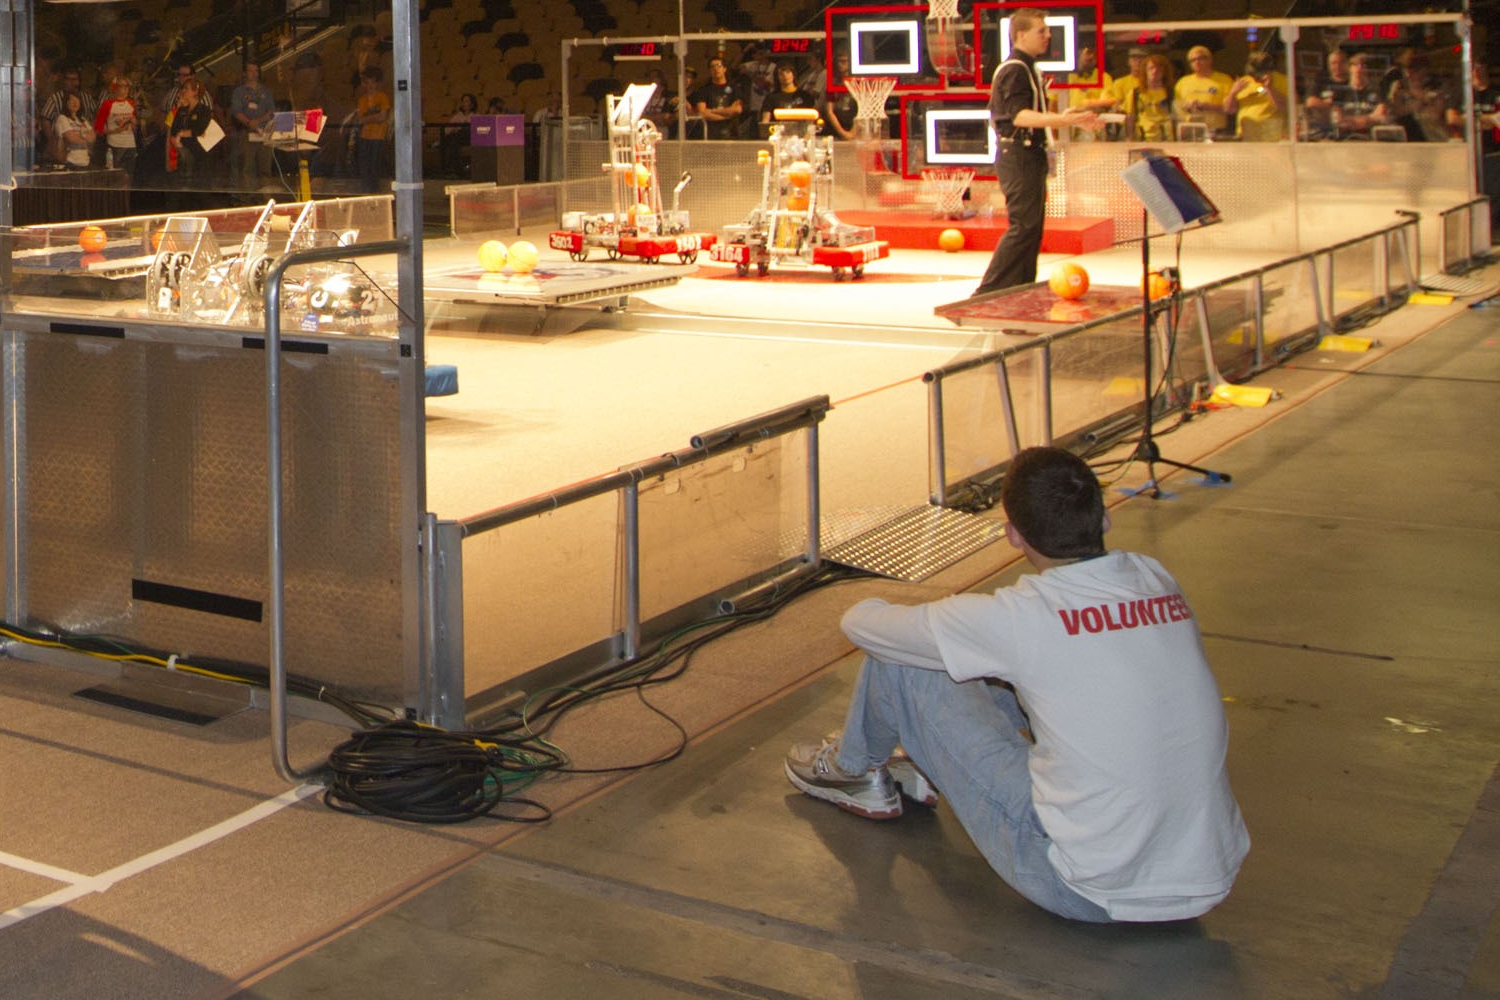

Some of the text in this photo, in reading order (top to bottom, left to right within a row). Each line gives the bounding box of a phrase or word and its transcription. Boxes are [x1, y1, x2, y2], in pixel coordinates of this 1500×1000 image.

[772, 39, 809, 53] 3242
[710, 243, 743, 263] 3164
[1058, 594, 1192, 635] VOLUNTEE
